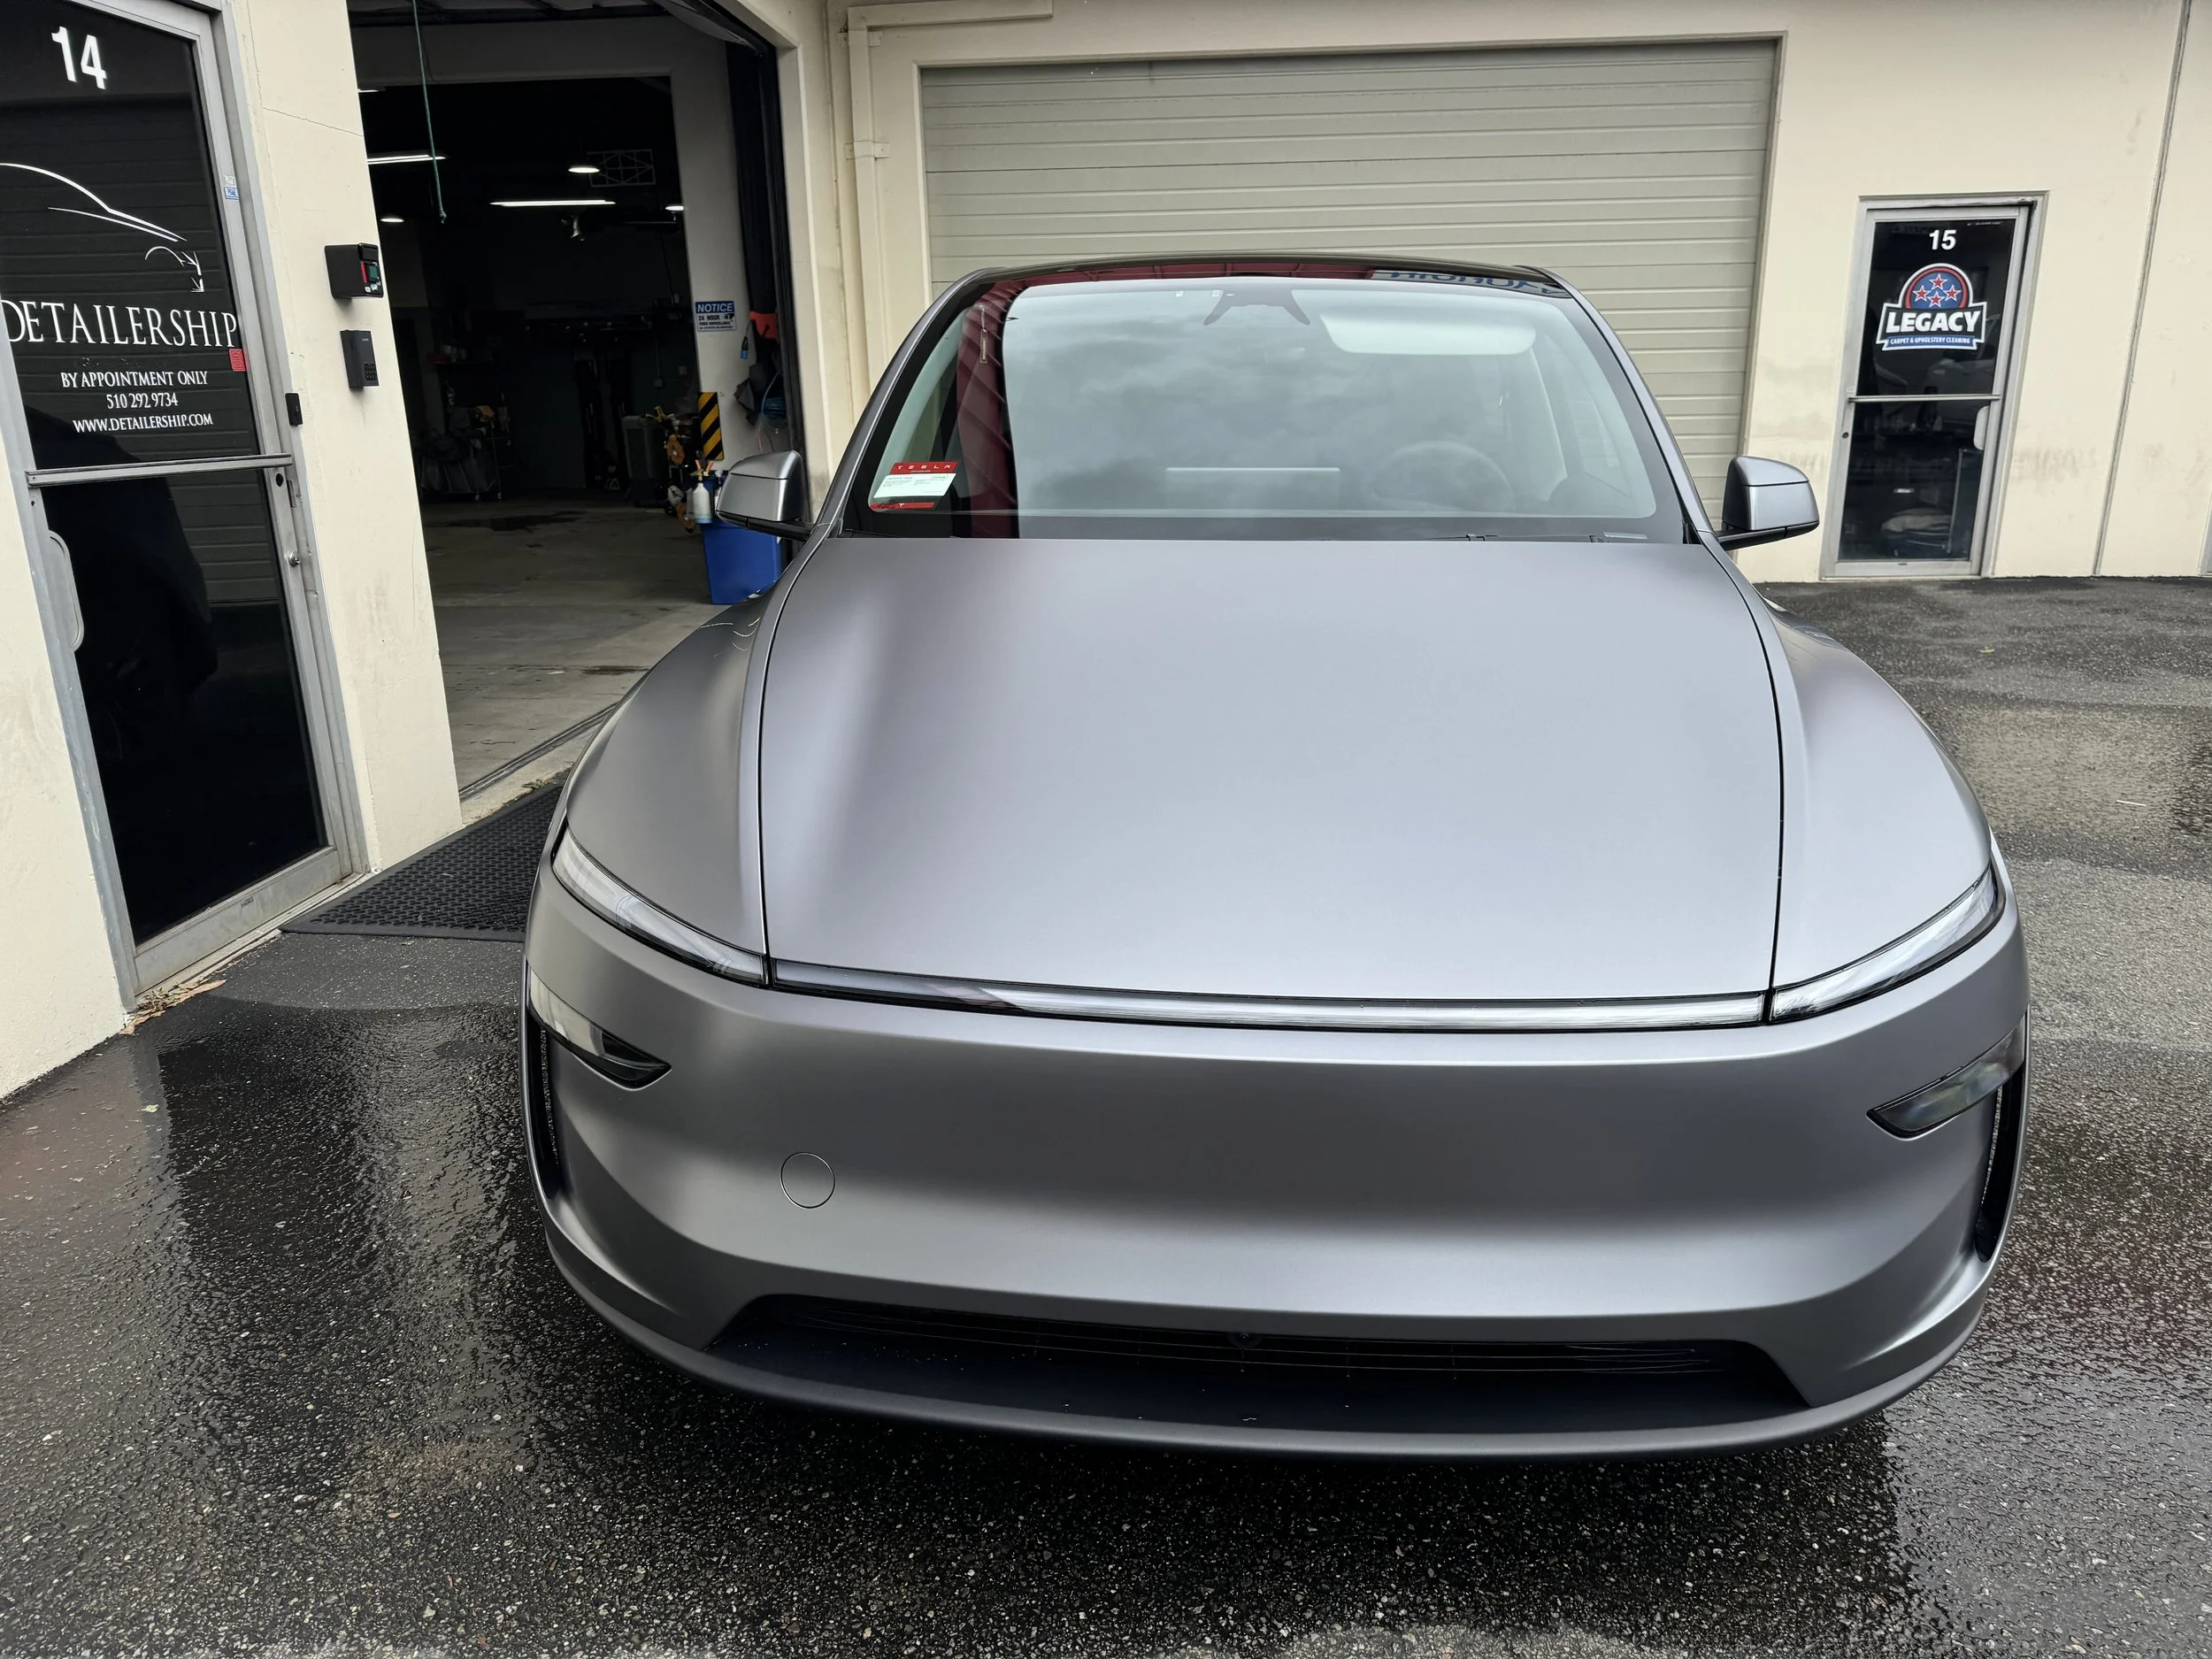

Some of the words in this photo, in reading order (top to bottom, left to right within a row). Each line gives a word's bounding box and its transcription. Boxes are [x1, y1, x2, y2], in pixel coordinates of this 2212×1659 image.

[51, 26, 108, 89] 14
[1929, 229, 1956, 250] 15
[697, 303, 733, 312] NOTICE
[1886, 311, 1981, 333] LEGACY
[60, 372, 78, 388] BY
[81, 371, 173, 388] APPOINTMENT
[177, 370, 208, 386] ONLY
[106, 393, 128, 410] 510
[128, 392, 151, 409] 292
[151, 391, 179, 408] 9734
[73, 413, 214, 434] WWW.DETAILERSHIP.COM
